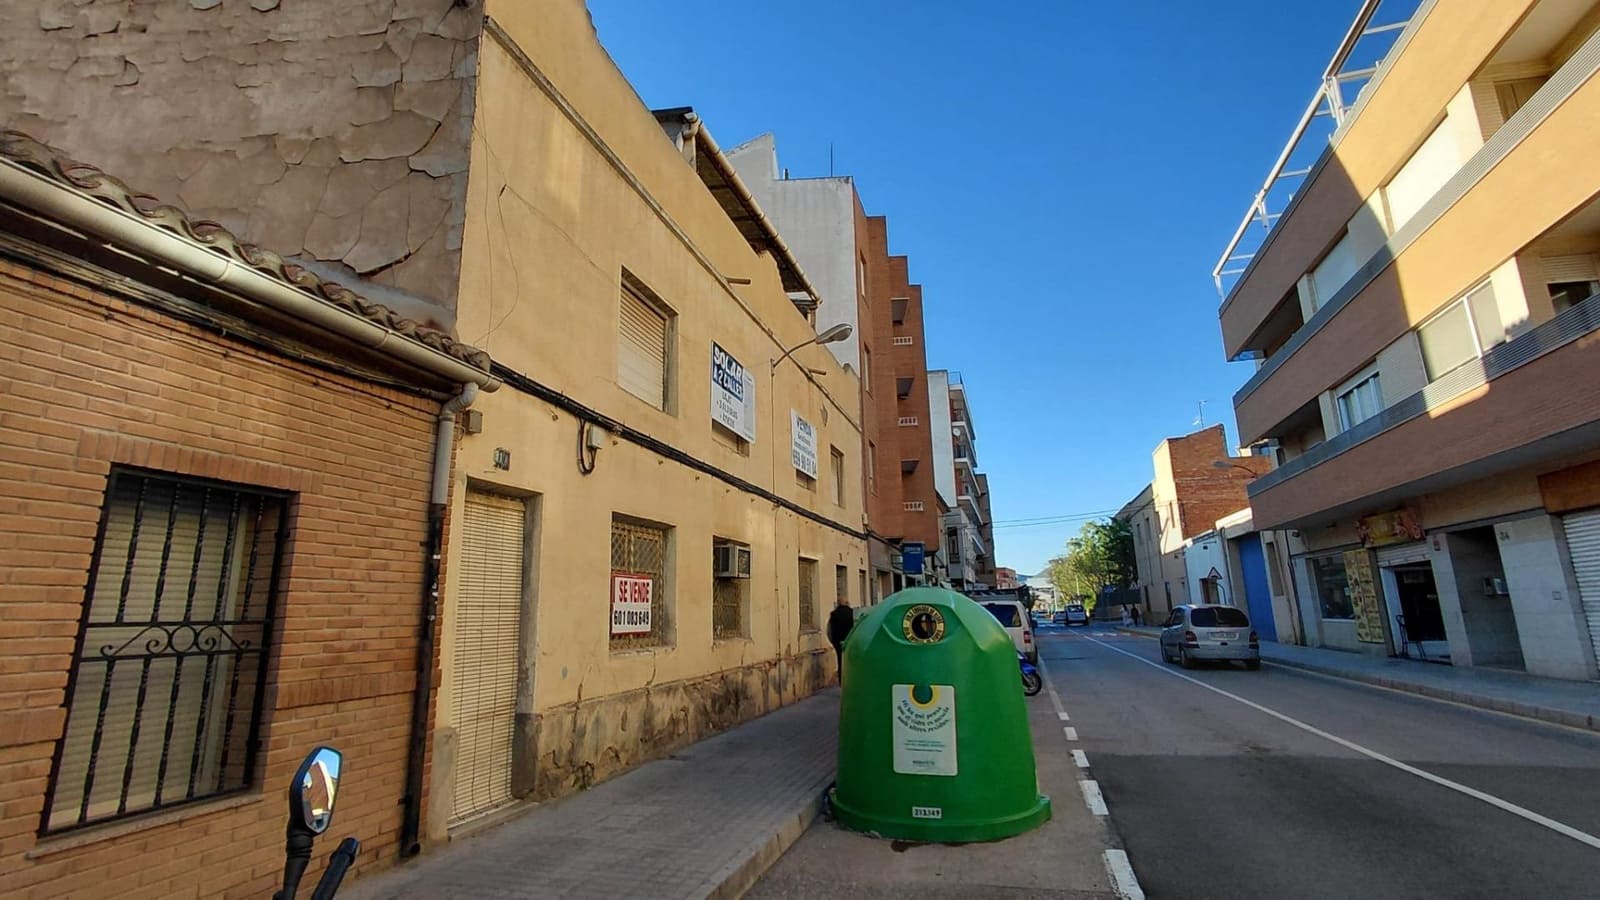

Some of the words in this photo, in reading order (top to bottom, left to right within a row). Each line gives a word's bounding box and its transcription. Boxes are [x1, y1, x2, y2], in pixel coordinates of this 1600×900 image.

[714, 346, 743, 383] SOLAR
[718, 369, 723, 384] 2
[723, 374, 743, 397] CALLES
[619, 580, 628, 602] SE
[630, 581, 650, 603] VENDE
